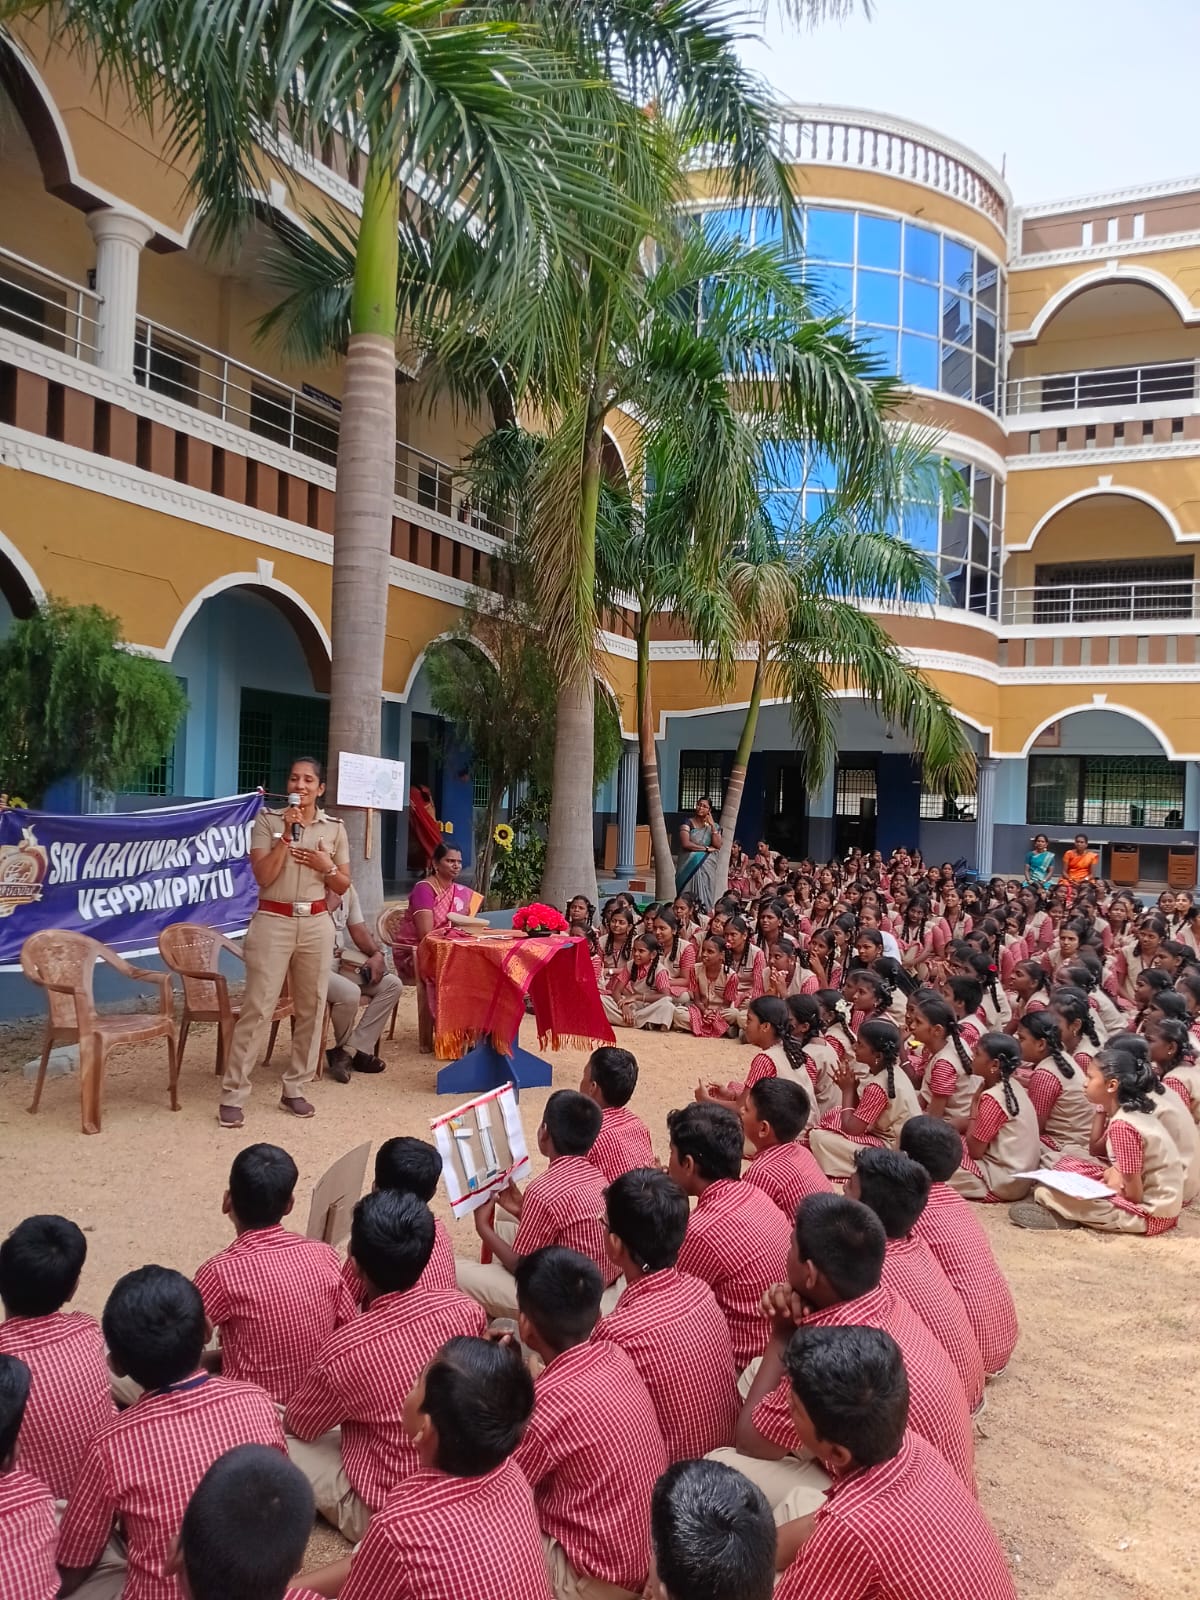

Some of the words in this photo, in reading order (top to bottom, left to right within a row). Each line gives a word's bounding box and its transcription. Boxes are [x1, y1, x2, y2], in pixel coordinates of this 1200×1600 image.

[48, 841, 86, 885] SRI
[195, 820, 256, 866] SCHO
[78, 867, 235, 921] VEPPAMPATTU
